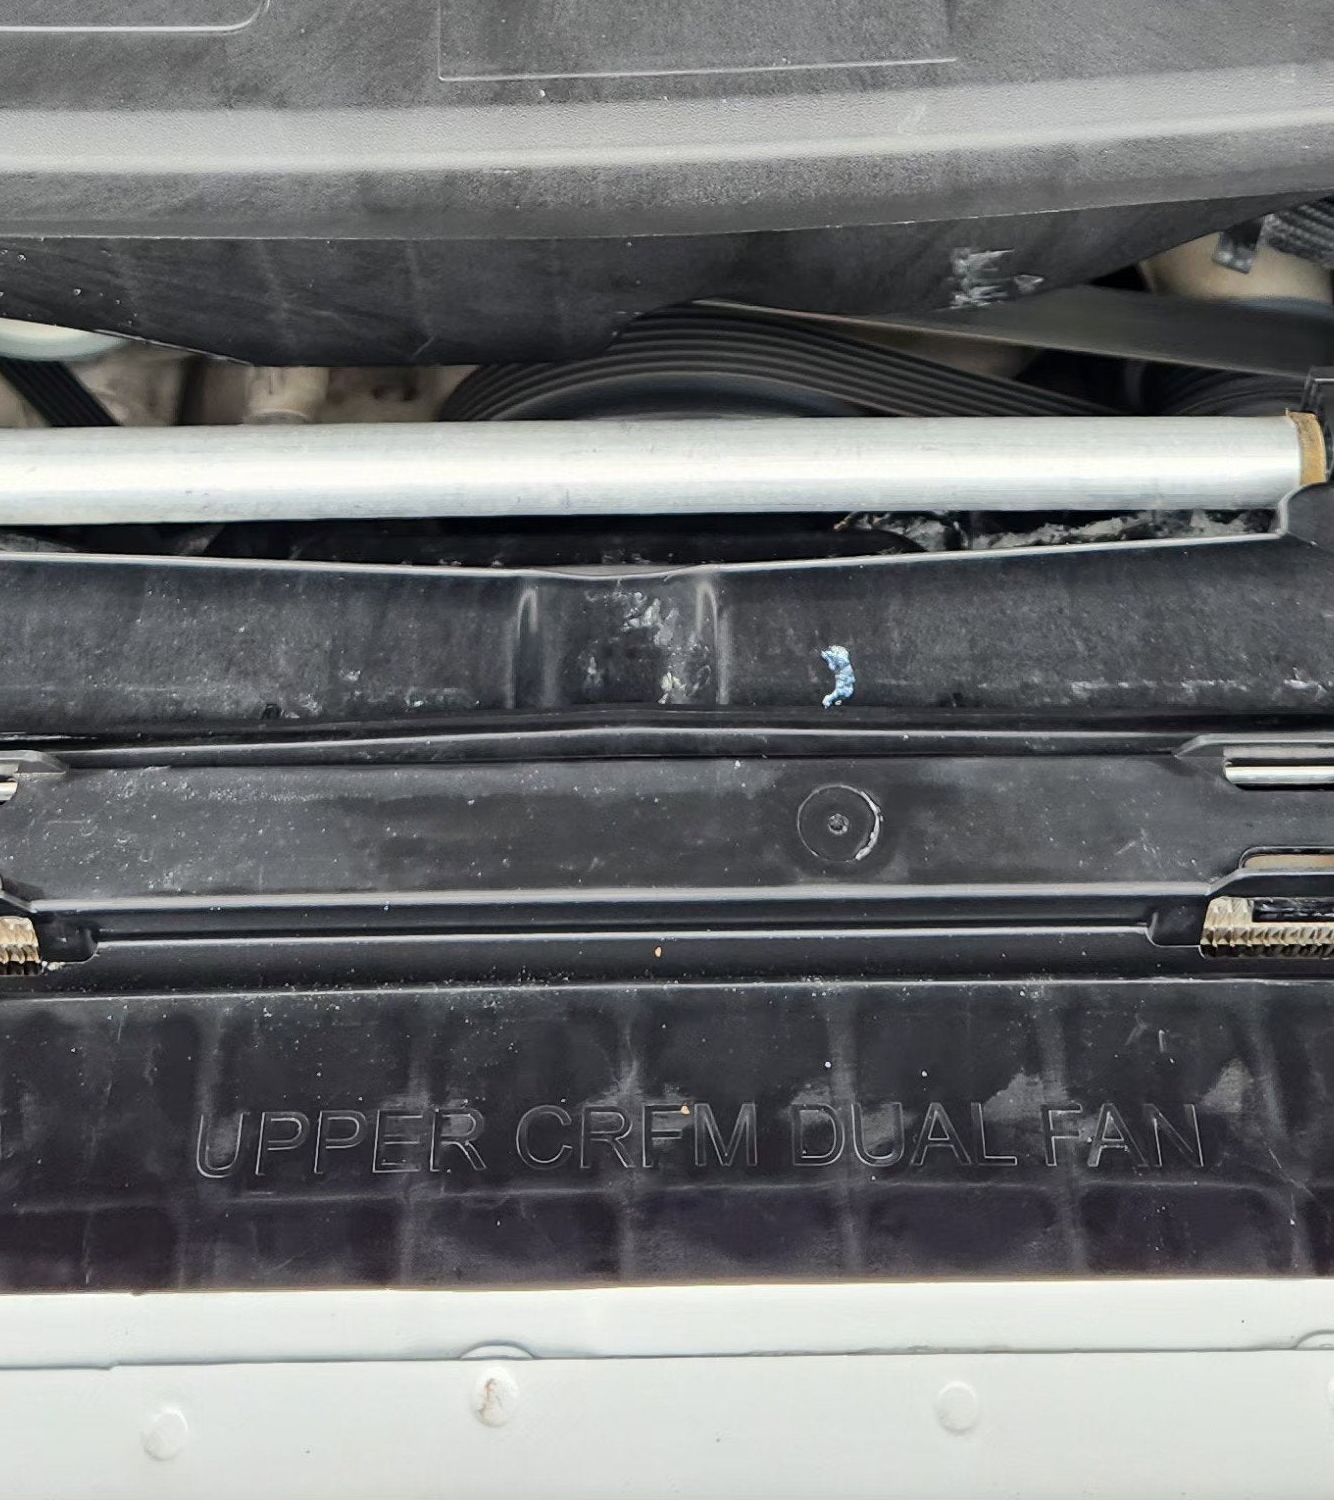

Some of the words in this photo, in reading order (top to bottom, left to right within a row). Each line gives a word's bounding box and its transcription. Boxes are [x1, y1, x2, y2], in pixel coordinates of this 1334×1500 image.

[195, 1108, 487, 1179] UPPER
[515, 1102, 759, 1171] CRFM
[790, 1101, 1018, 1168] DUAL
[1040, 1101, 1205, 1168] FAN
